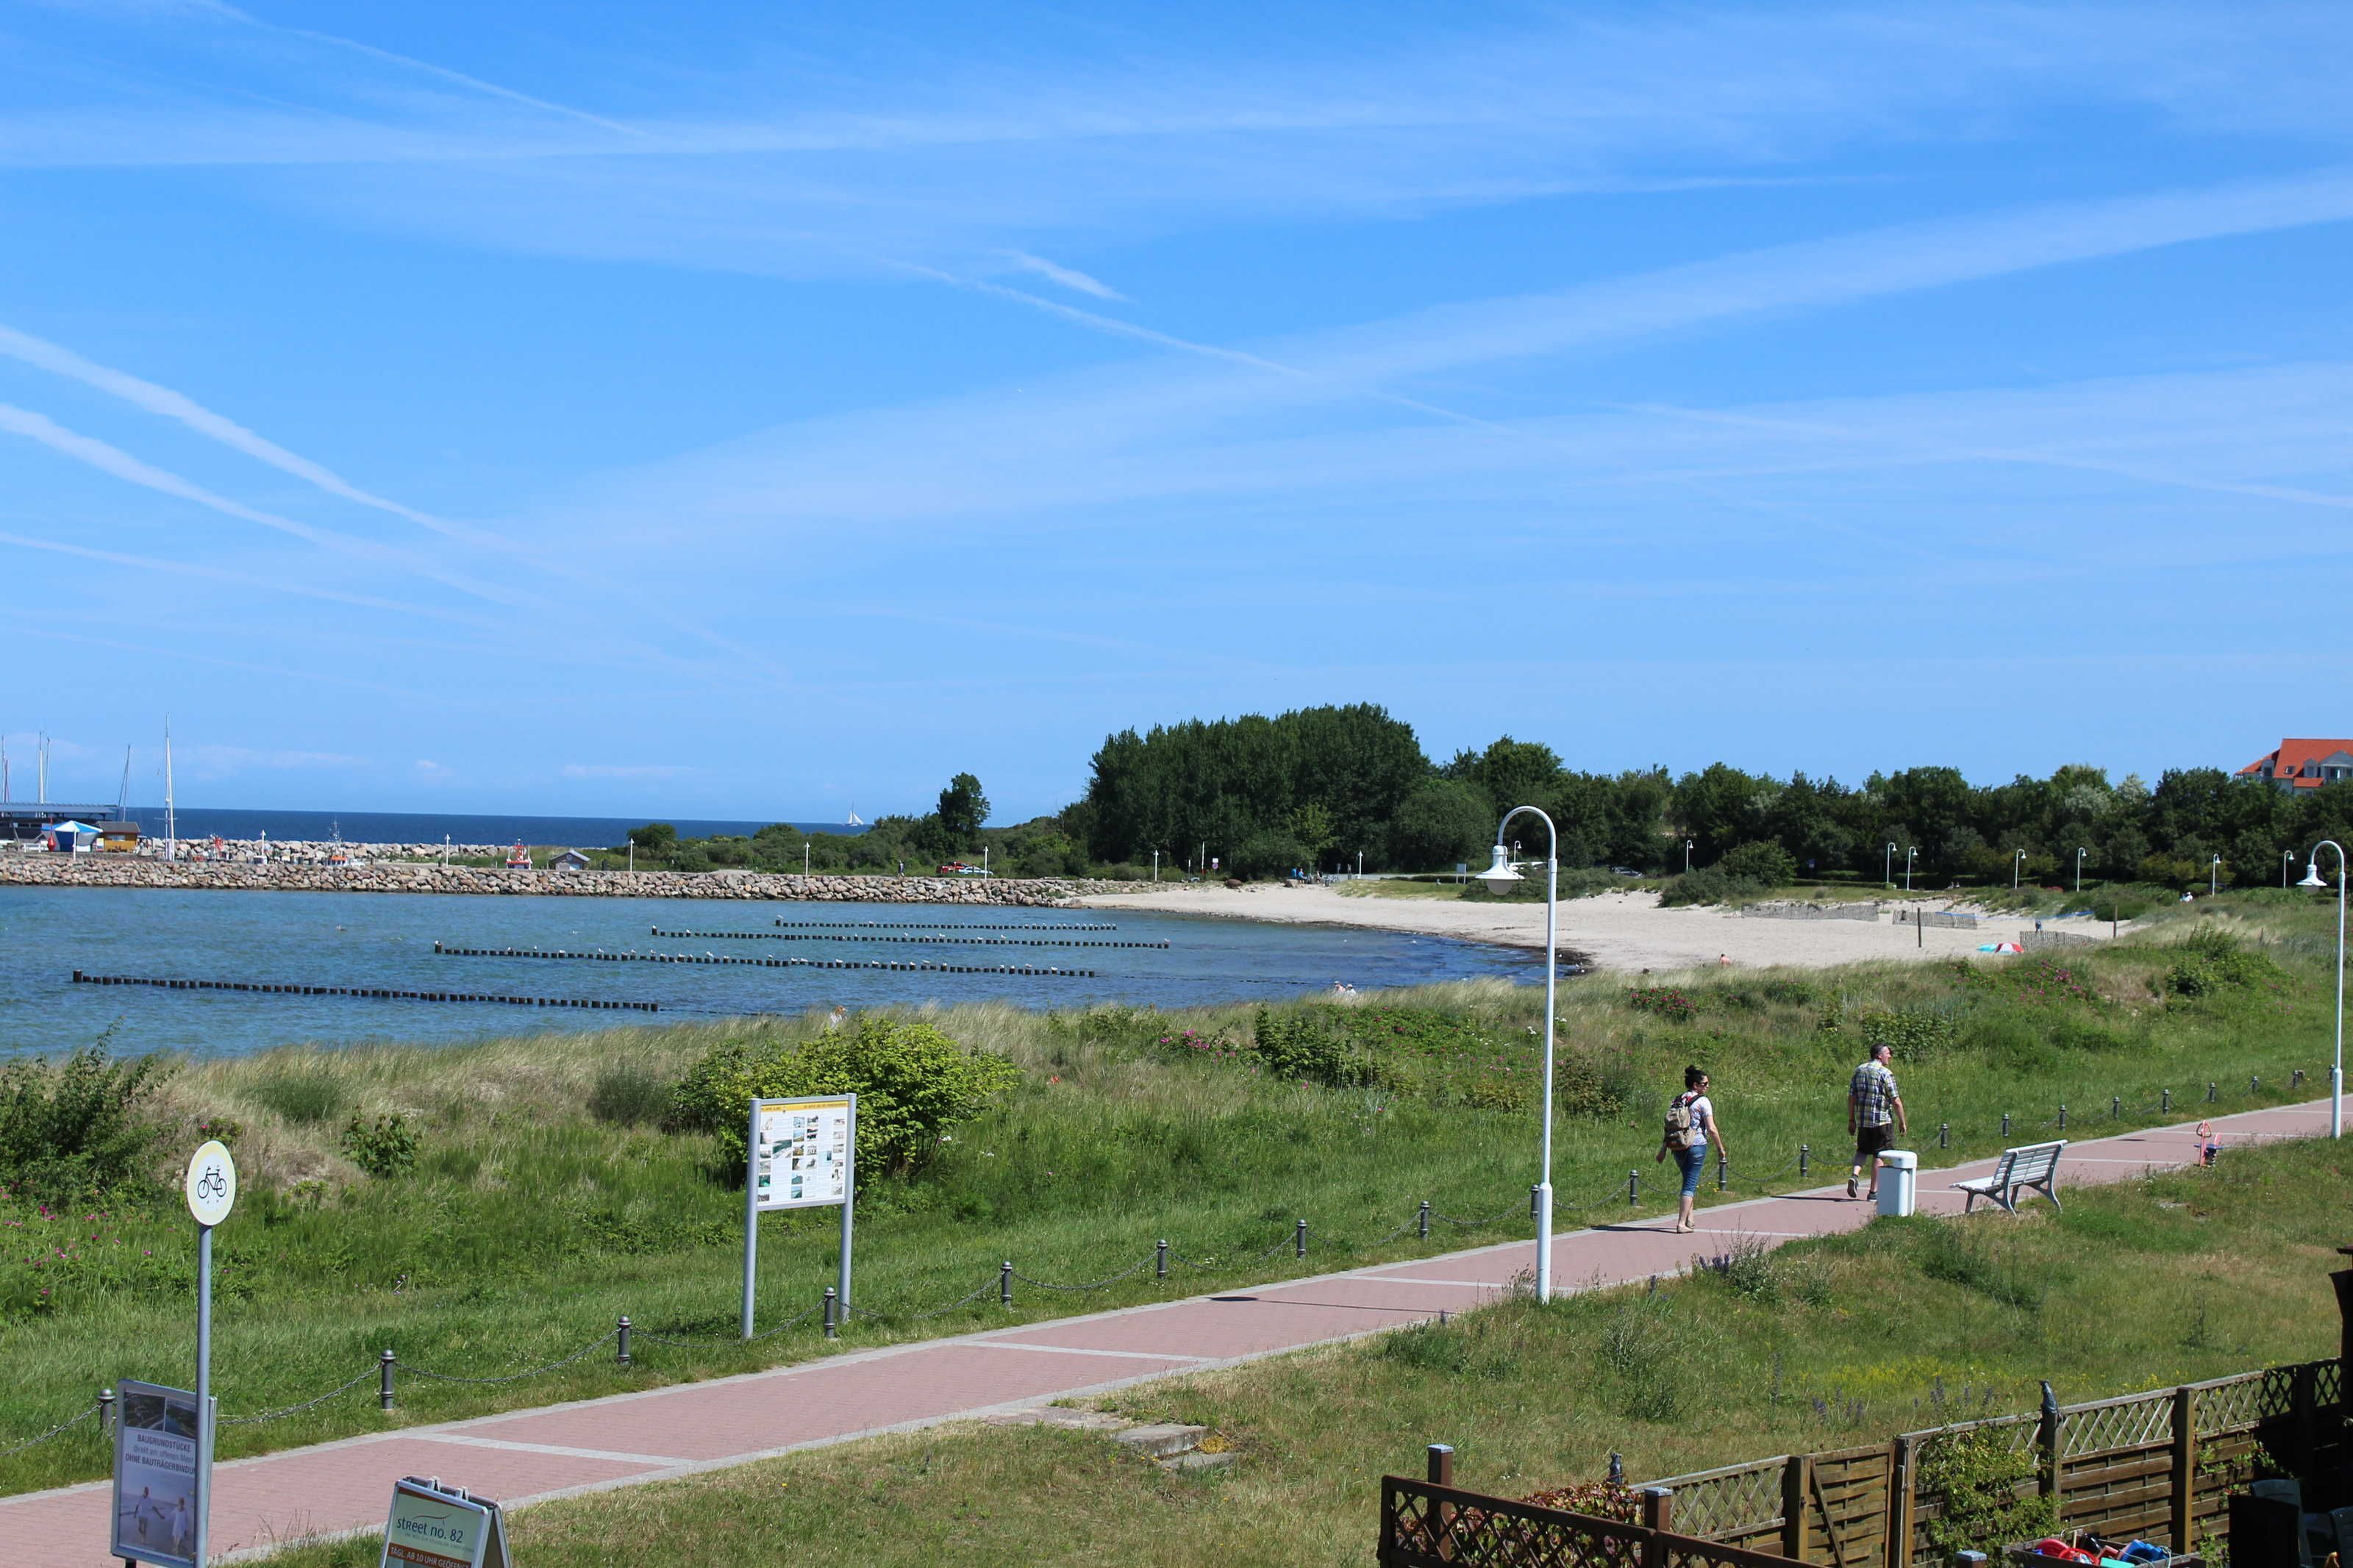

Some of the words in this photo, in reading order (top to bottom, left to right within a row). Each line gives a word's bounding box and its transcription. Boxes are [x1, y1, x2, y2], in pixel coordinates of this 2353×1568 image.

[138, 1434, 191, 1453] BAUGRUNDSTÜCKE
[125, 1453, 141, 1464] OHNE
[430, 1526, 447, 1539] no.
[449, 1529, 464, 1543] 82
[407, 1551, 415, 1560] AB
[417, 1553, 424, 1562] 10
[424, 1555, 438, 1566] UHR
